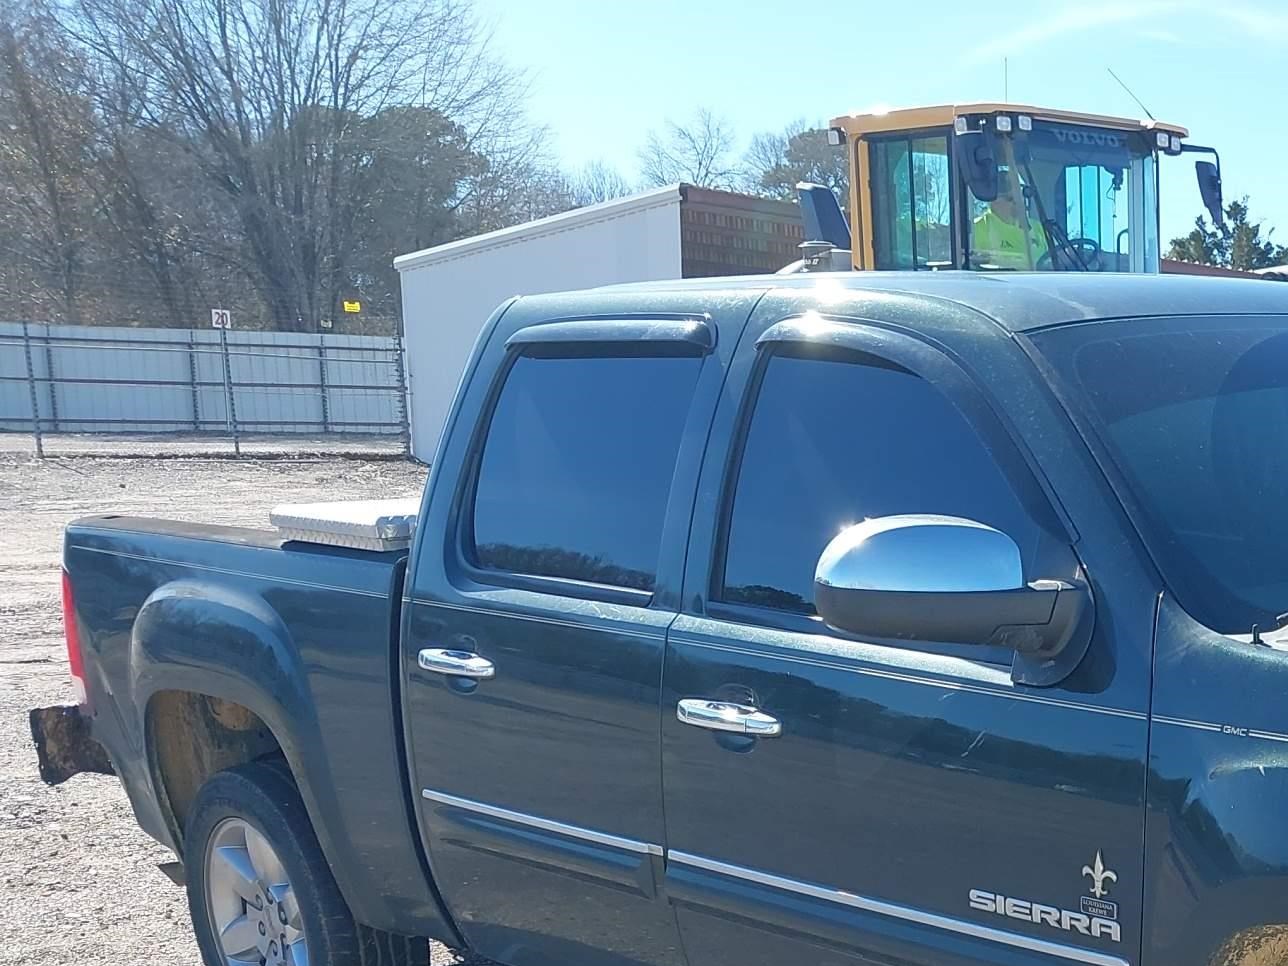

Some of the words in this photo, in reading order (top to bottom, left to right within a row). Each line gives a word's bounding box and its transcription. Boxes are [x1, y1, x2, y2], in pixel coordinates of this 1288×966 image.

[1051, 129, 1120, 147] VOLVO
[214, 311, 229, 326] 20
[1223, 725, 1248, 737] GMC
[1083, 899, 1113, 910] LOUISIANA
[969, 889, 1121, 942] SIERRA
